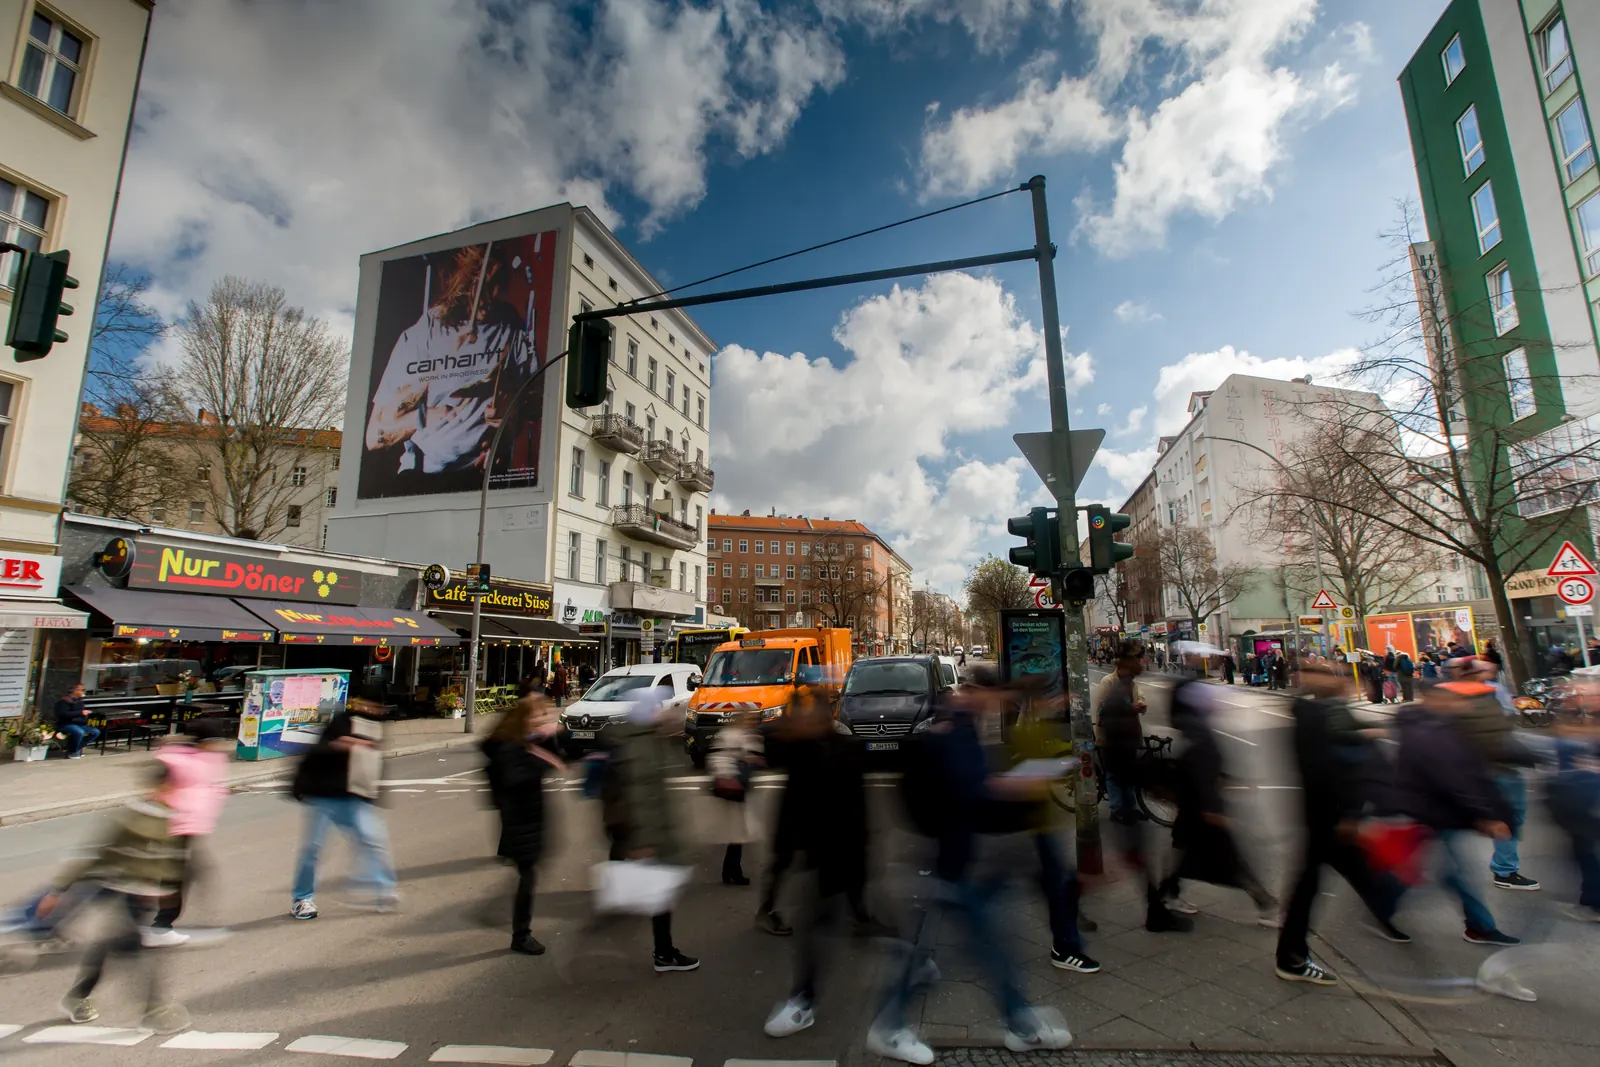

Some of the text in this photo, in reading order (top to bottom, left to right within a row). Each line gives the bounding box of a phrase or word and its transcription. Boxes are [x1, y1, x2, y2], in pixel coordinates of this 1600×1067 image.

[406, 347, 505, 375] carhartt
[418, 368, 490, 383] WORK IN PROGRESS
[0, 557, 45, 580] ER
[158, 547, 306, 595] Nur Döner
[1507, 579, 1536, 591] GRAND
[1564, 583, 1587, 597] 30
[433, 585, 550, 610] Café äckerei Süss
[34, 617, 73, 627] HATAY
[274, 609, 323, 623] Nur
[118, 626, 138, 635] Nur
[222, 630, 238, 639] Nur
